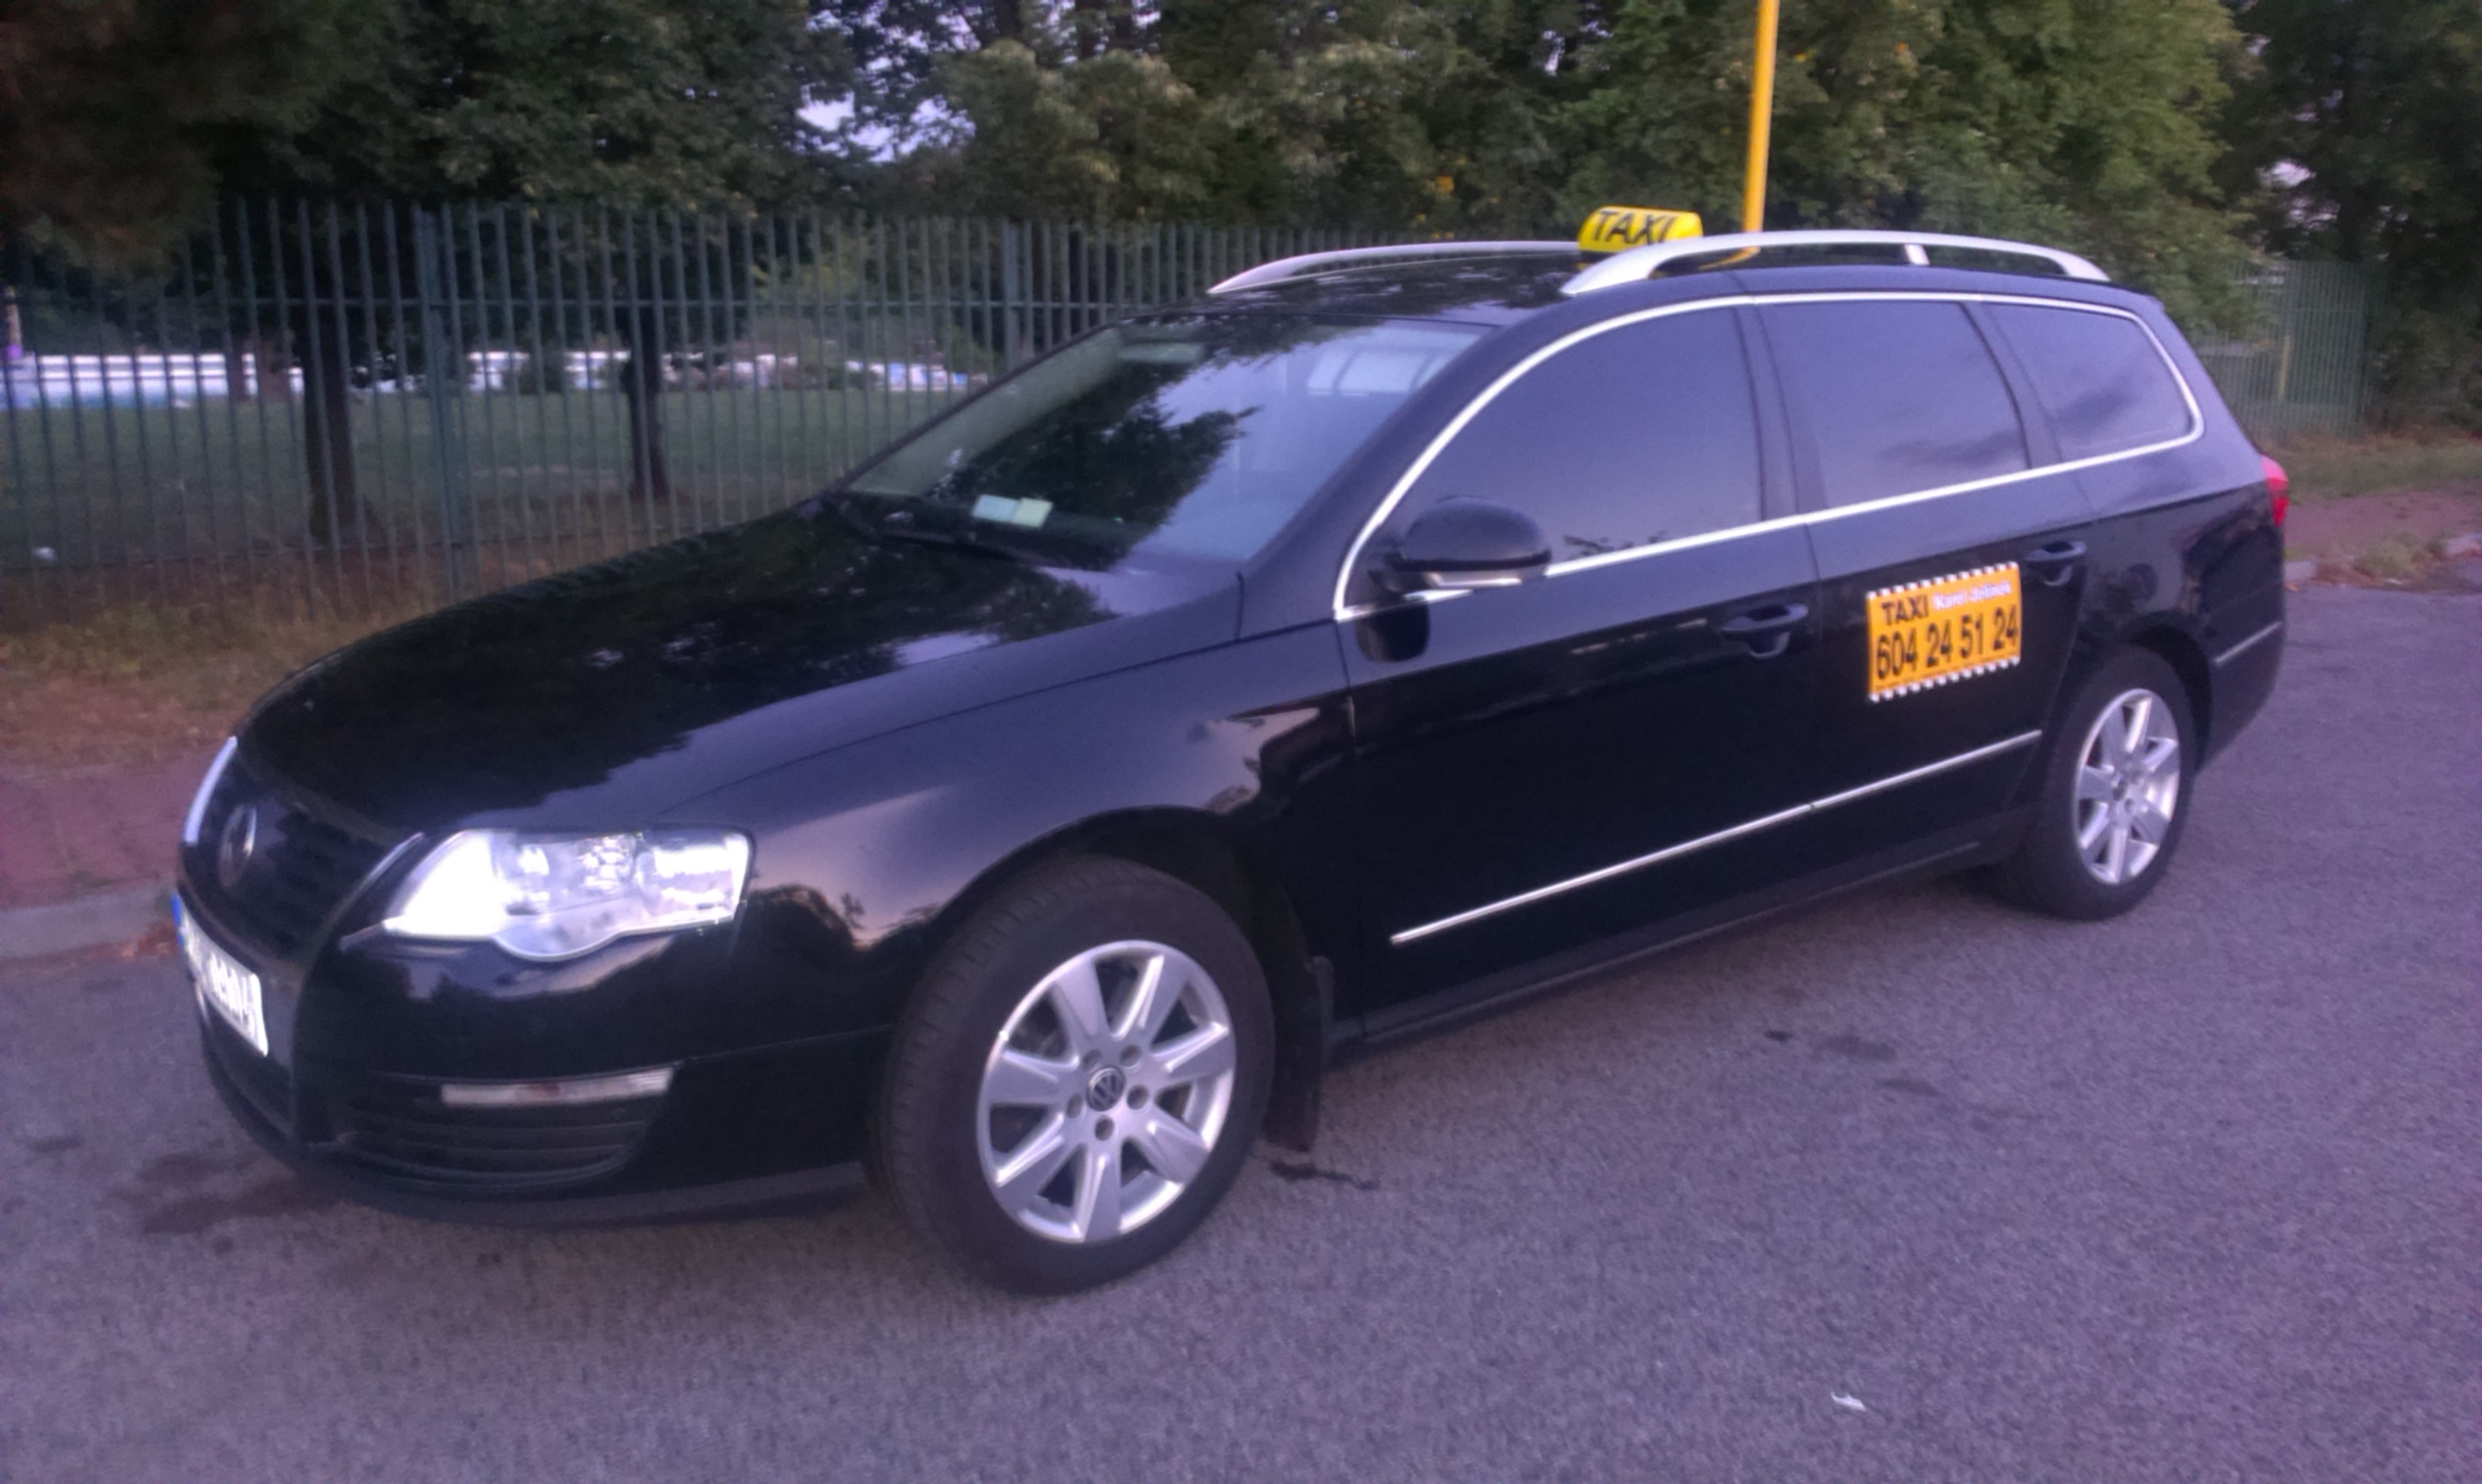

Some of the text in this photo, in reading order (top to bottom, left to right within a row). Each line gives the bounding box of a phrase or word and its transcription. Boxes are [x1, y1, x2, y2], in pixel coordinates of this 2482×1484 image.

[1594, 210, 1677, 245] TAXI
[1881, 594, 1930, 626] TAXI
[1876, 626, 1919, 680] 604
[1925, 618, 1954, 668] 24
[1959, 610, 1985, 660] 51
[1992, 603, 2020, 652] 24
